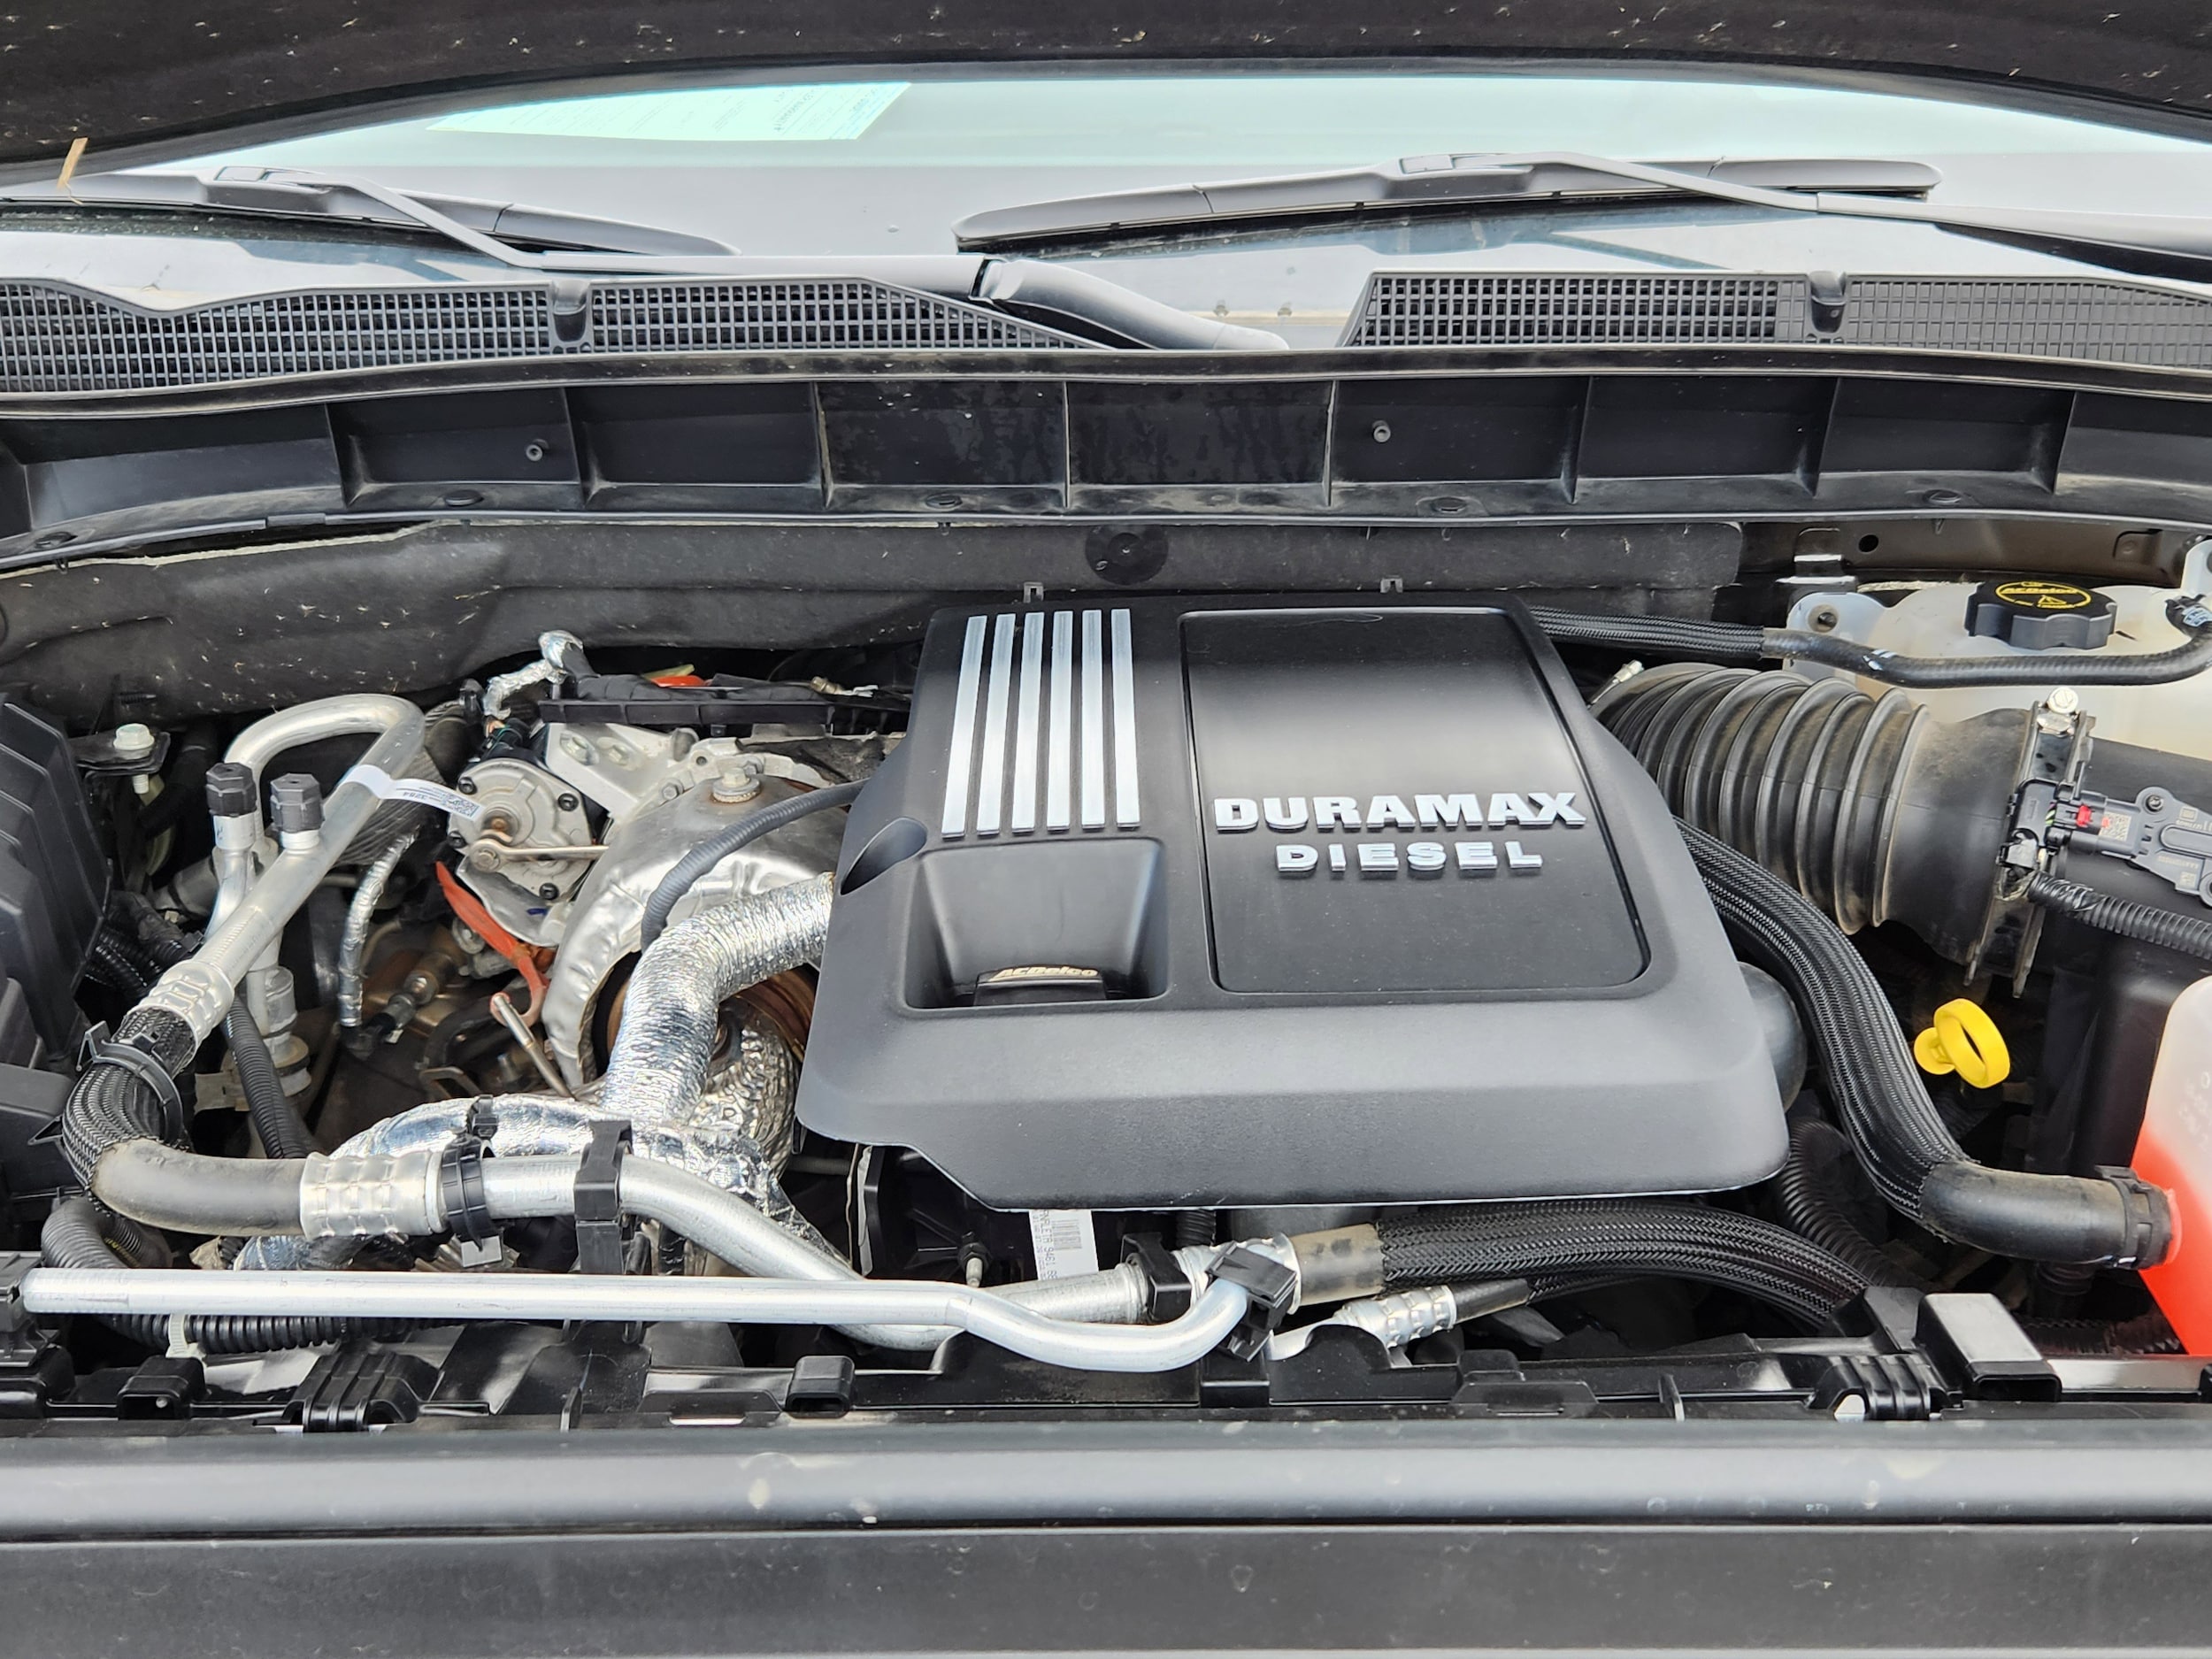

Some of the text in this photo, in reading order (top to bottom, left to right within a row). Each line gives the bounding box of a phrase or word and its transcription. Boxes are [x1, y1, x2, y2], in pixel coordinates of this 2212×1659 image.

[1214, 793, 1586, 832] DURAMAX
[1275, 841, 1542, 872] DIESEL
[988, 966, 1099, 982] ACDelco
